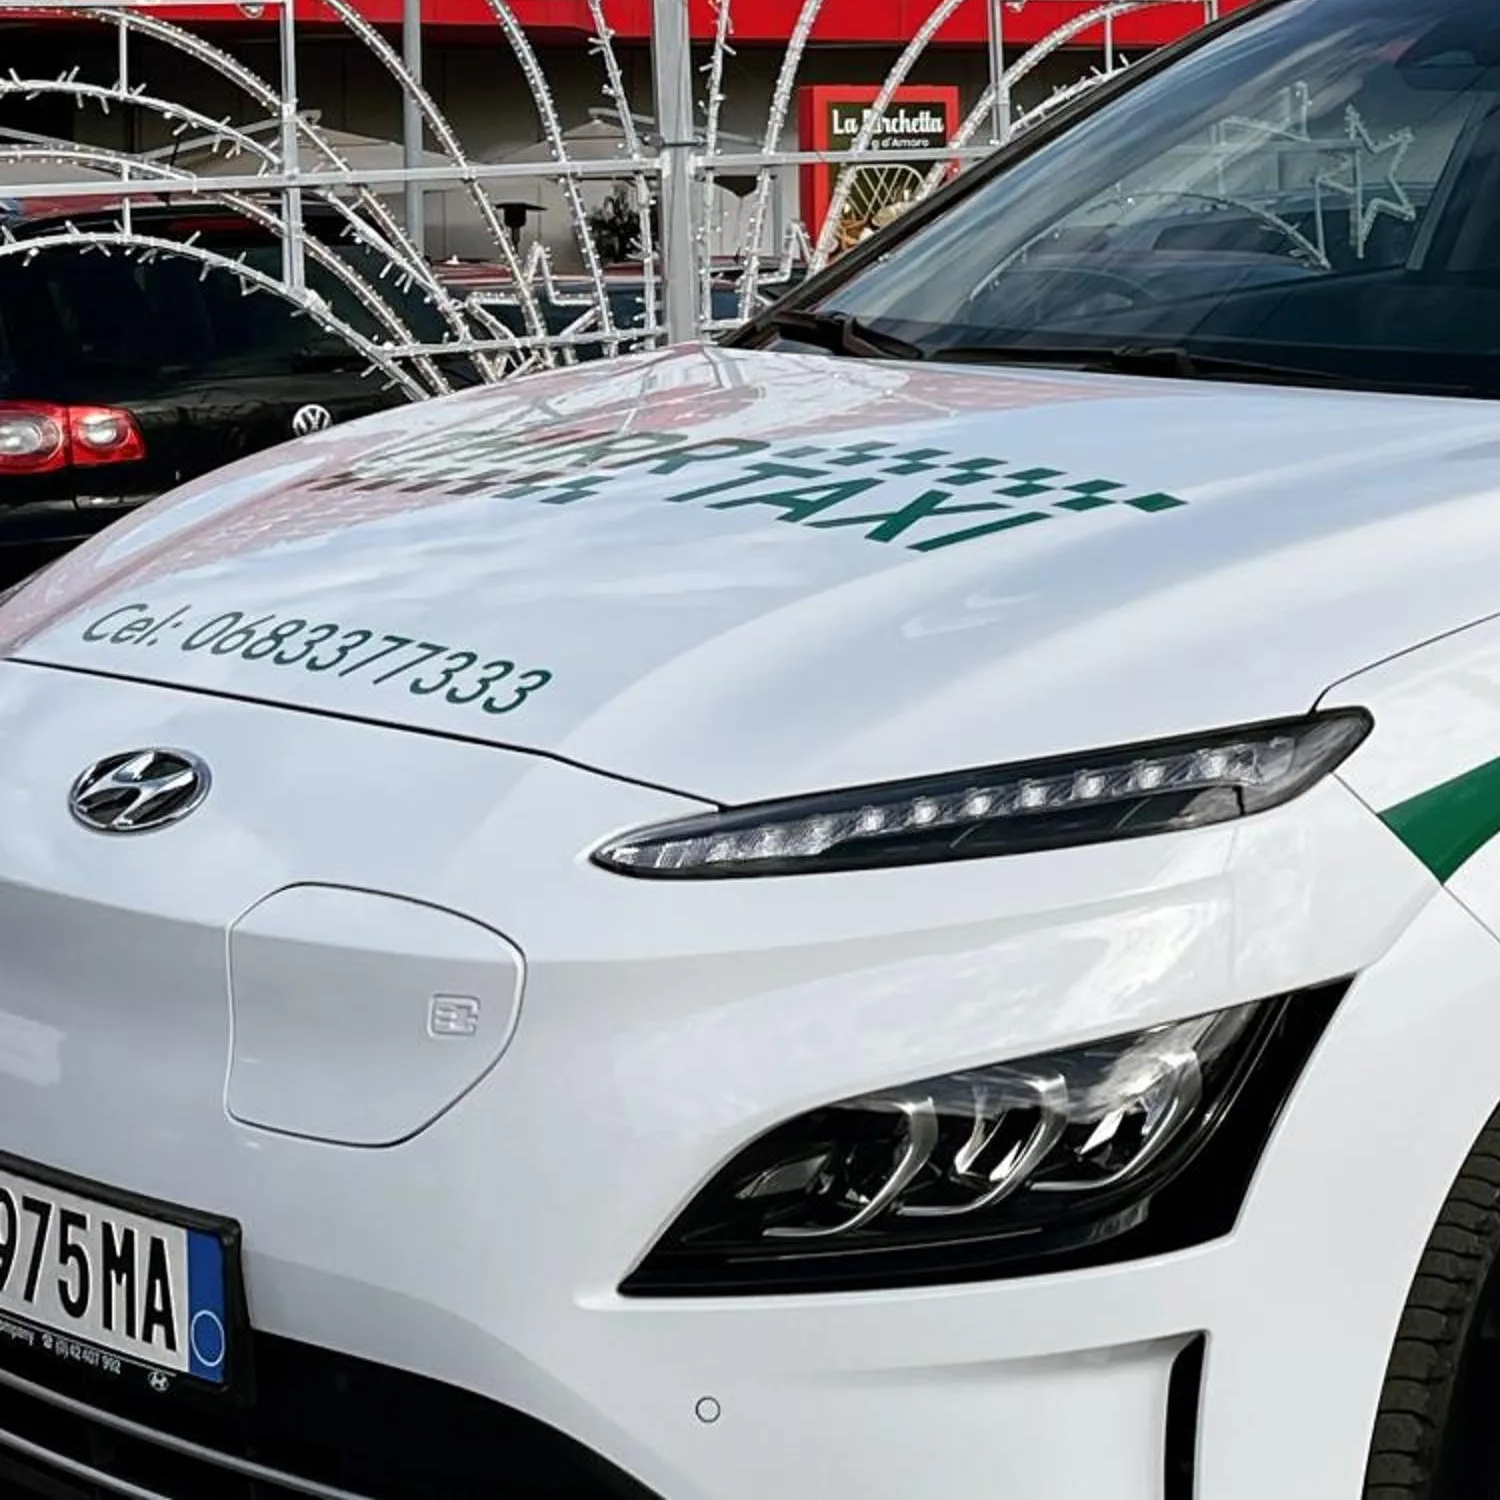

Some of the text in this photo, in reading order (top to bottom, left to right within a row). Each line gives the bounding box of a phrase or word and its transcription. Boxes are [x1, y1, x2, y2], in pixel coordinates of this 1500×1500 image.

[832, 109, 858, 135] La
[664, 461, 1055, 553] TAXI
[81, 602, 554, 715] Cel: 0683377333
